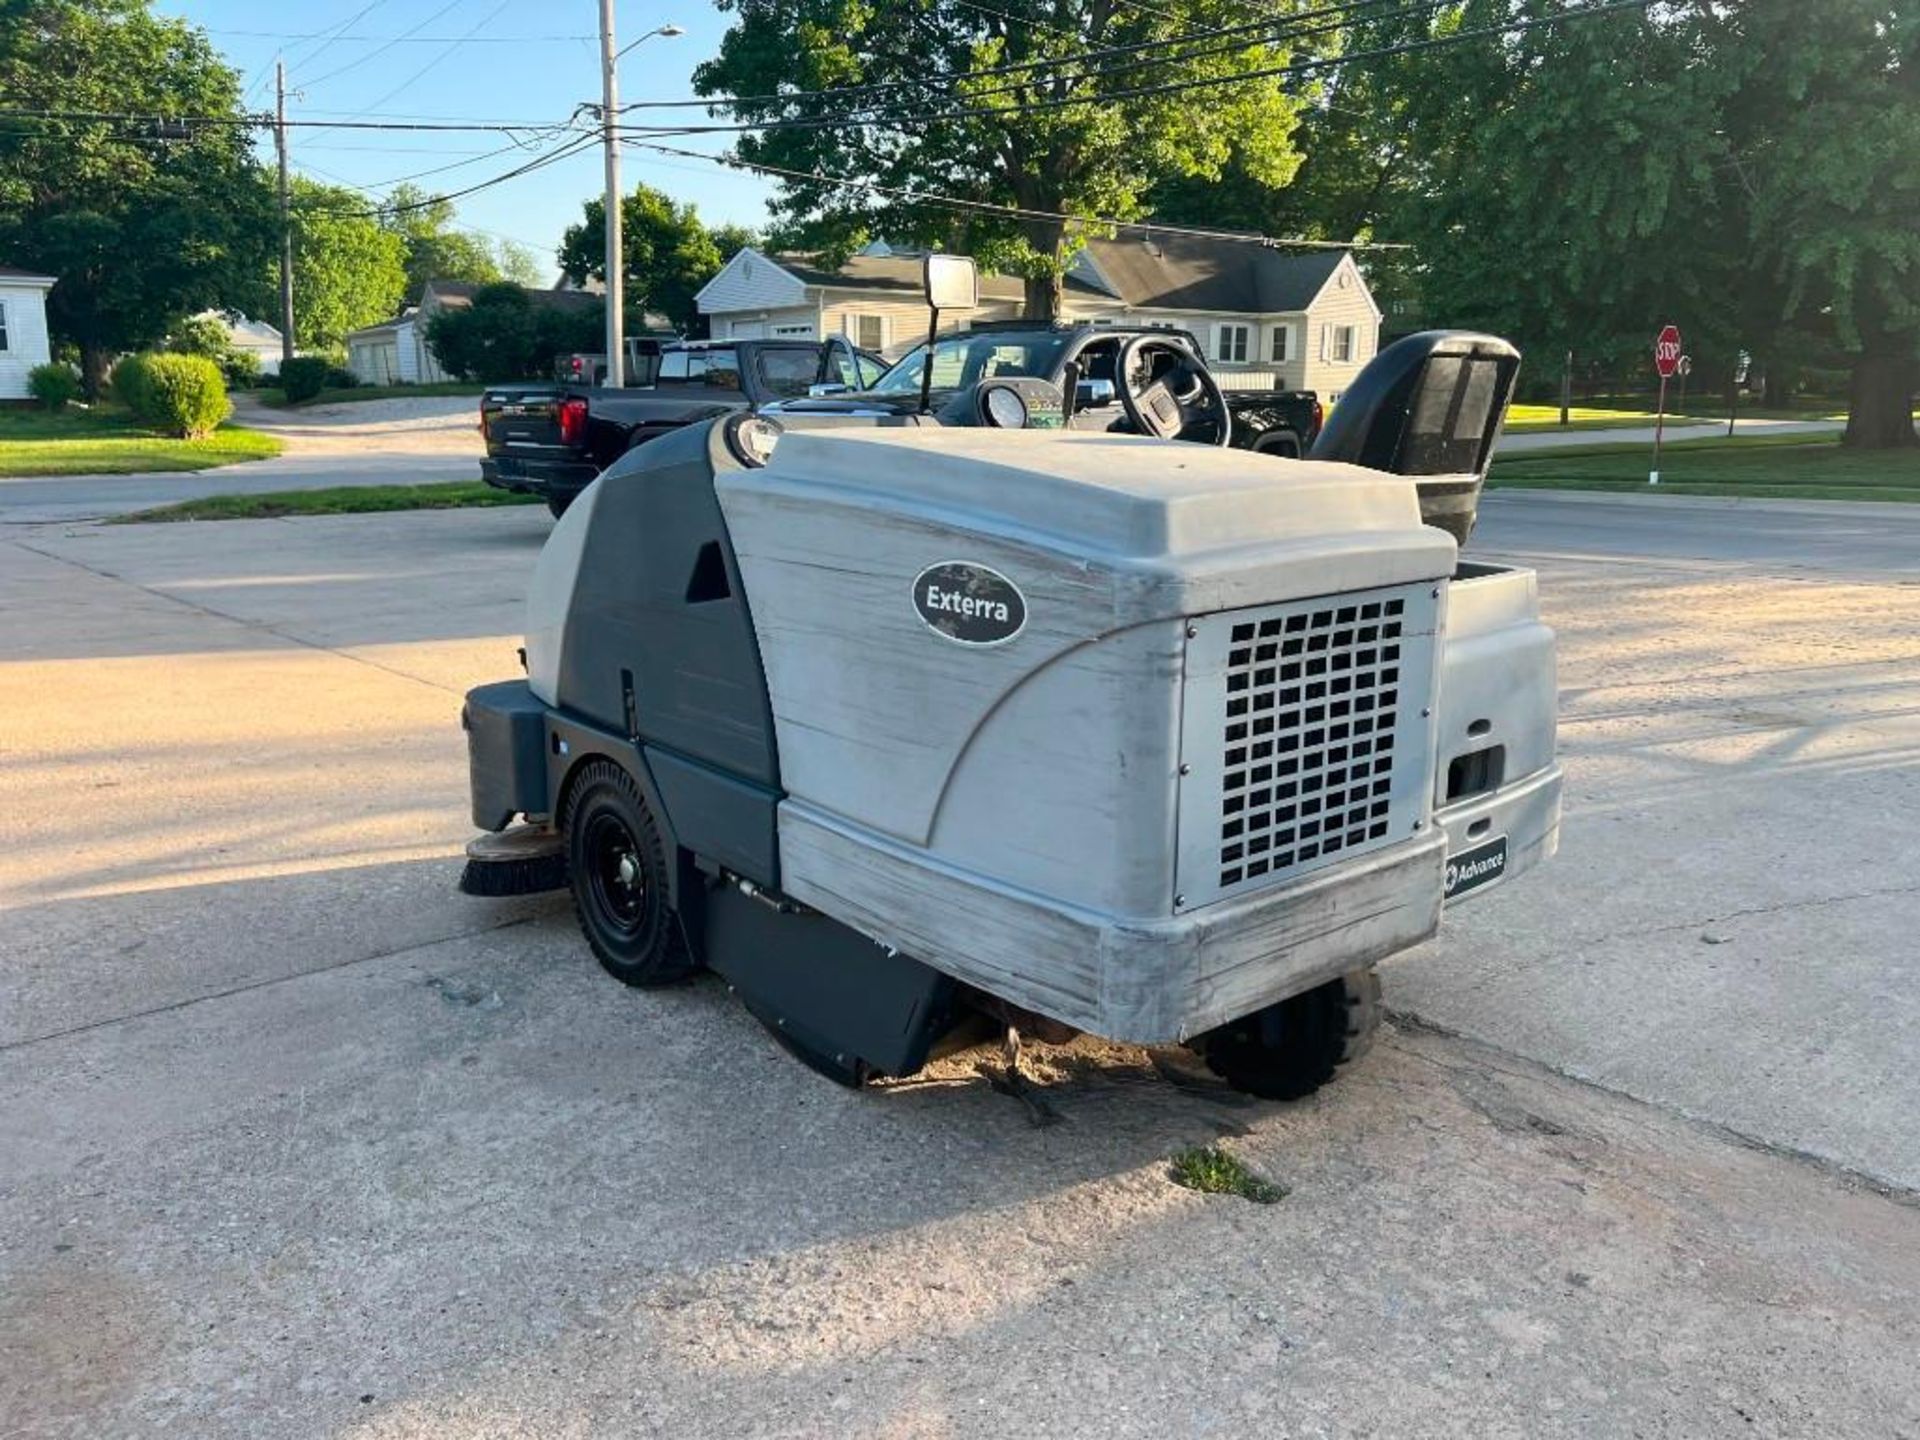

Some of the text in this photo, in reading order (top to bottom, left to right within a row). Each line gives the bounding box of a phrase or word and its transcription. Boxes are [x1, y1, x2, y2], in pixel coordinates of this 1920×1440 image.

[1659, 342, 1680, 361] STOP
[926, 585, 1009, 622] Exterra
[1458, 852, 1504, 882] Advance
